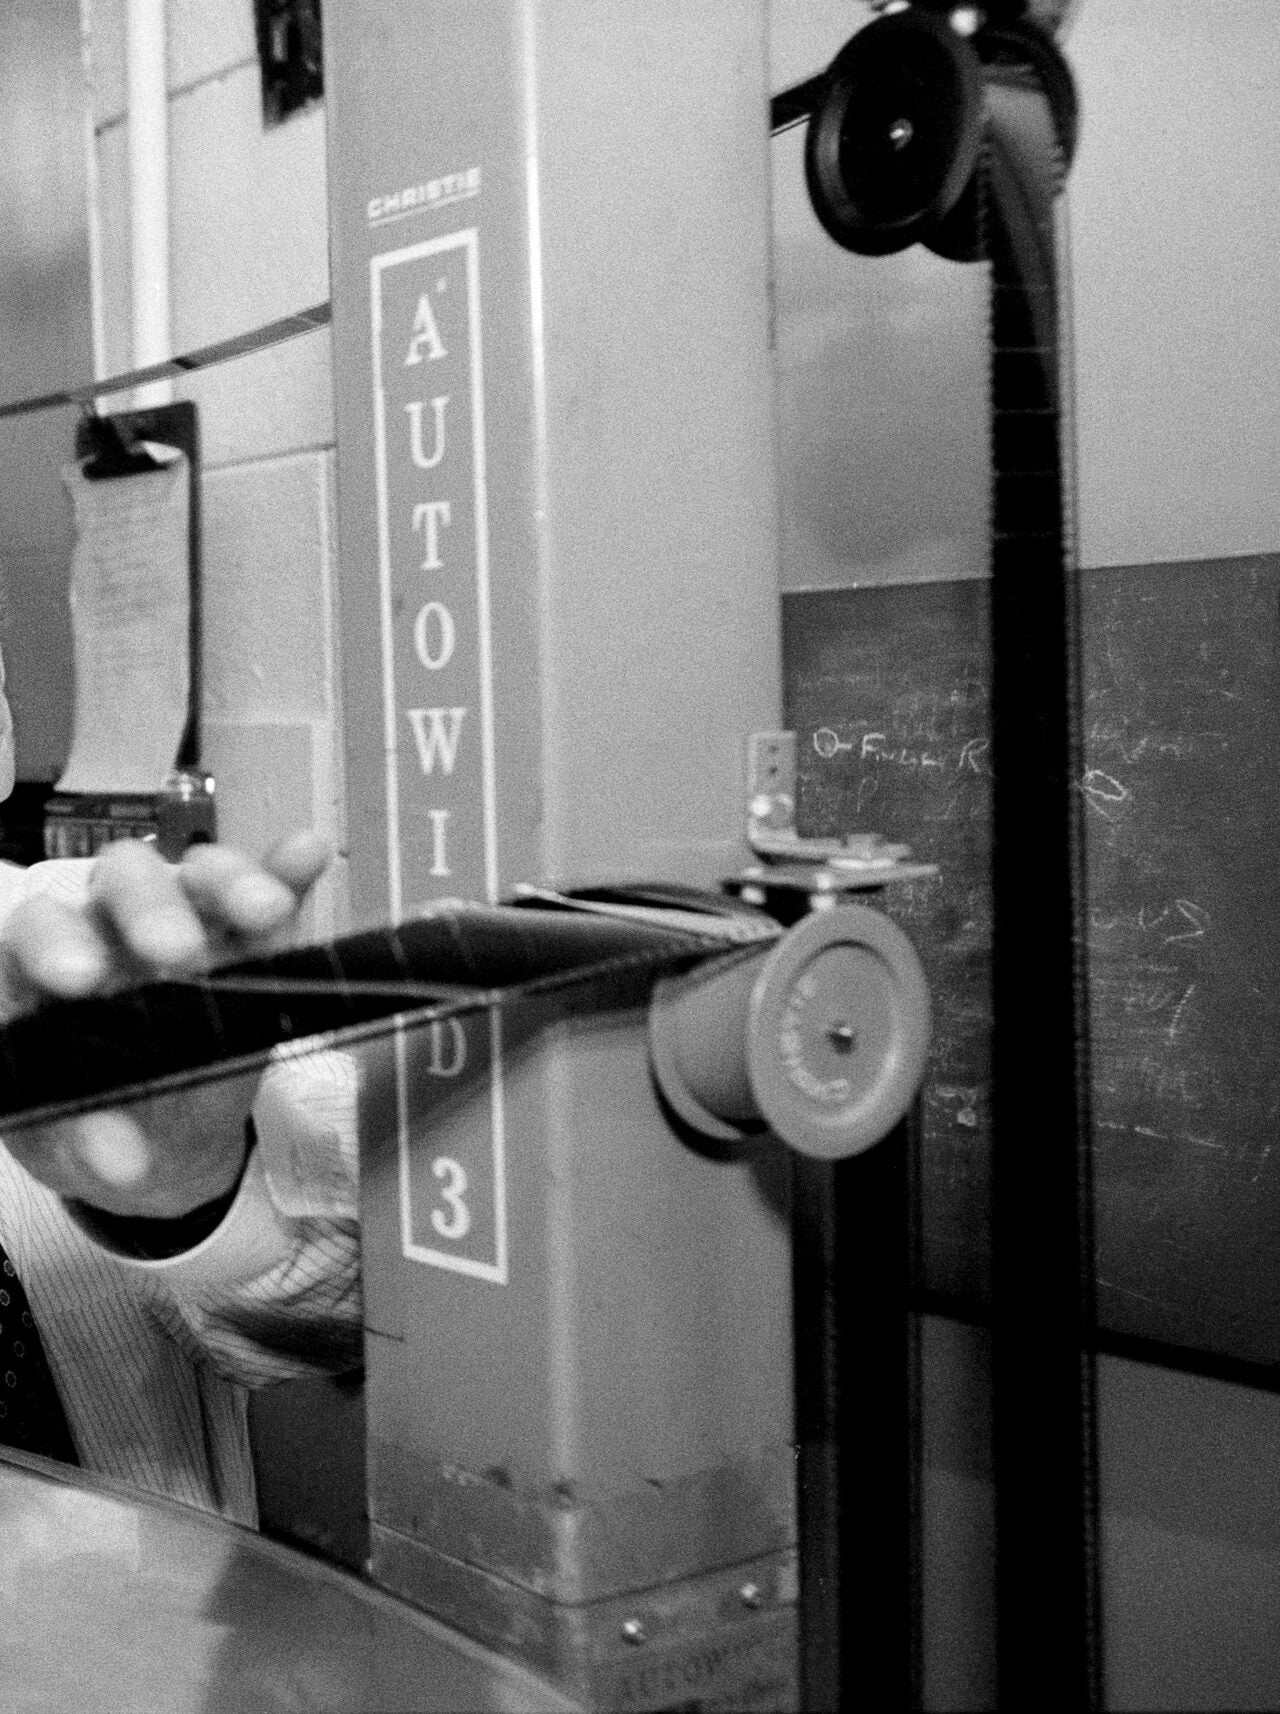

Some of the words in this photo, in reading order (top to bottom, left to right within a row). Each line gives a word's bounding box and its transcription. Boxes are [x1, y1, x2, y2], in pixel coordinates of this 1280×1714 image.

[367, 166, 481, 219] CHRISTIE
[404, 293, 468, 1077] AUTOWID
[430, 1156, 471, 1240] 3
